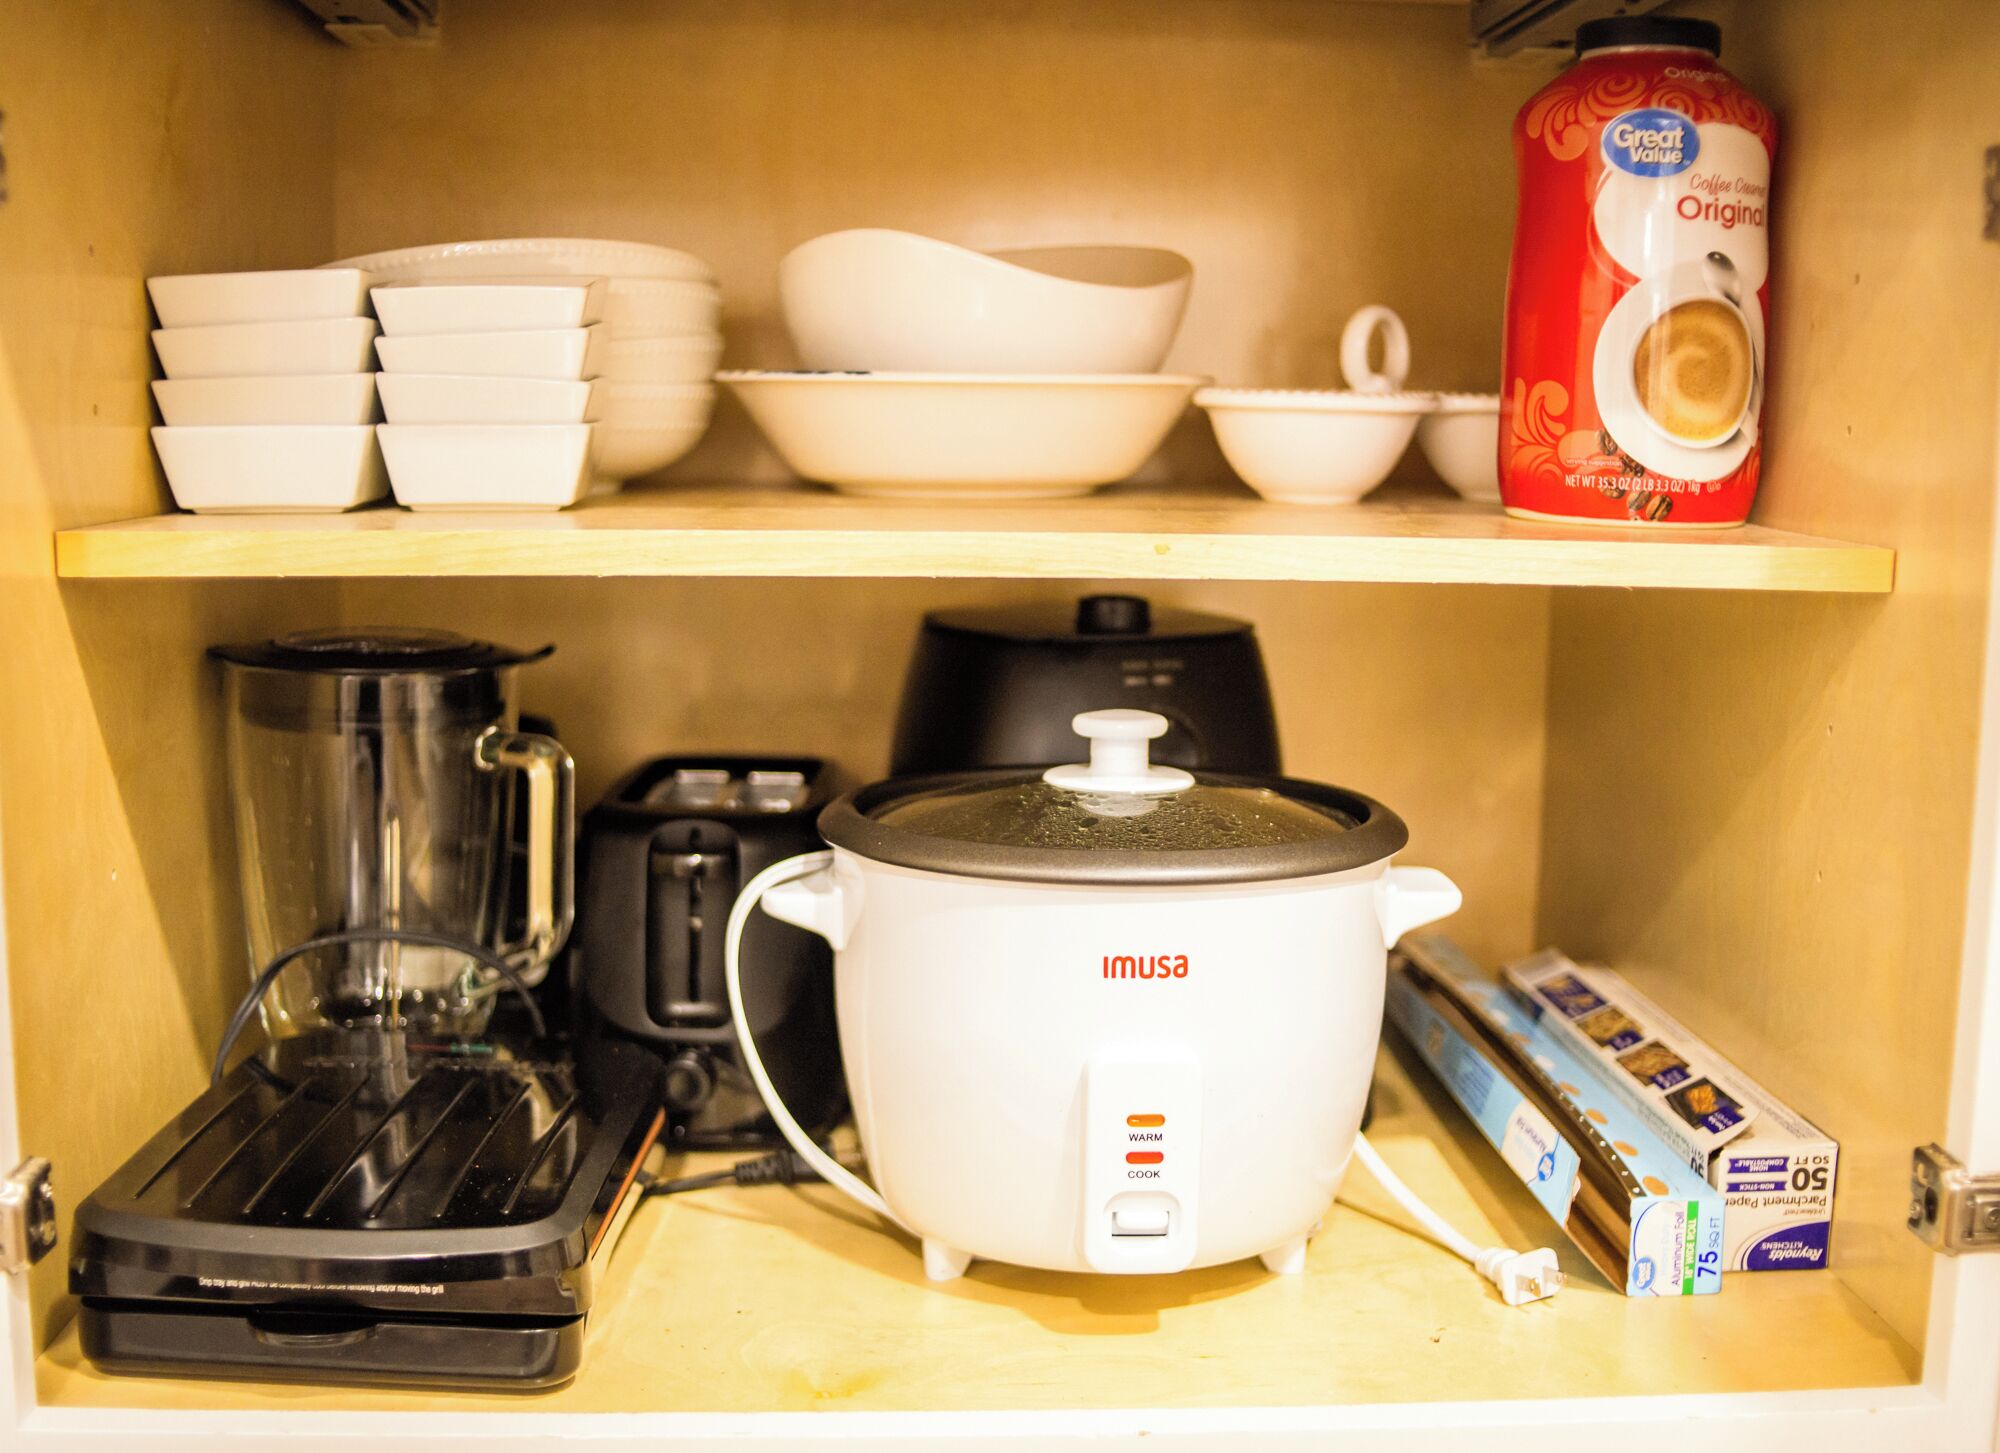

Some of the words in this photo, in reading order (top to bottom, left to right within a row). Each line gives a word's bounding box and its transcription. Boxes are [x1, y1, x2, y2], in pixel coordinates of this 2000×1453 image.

[1613, 123, 1684, 149] Great
[1630, 147, 1683, 164] Value
[1690, 173, 1732, 196] Coffee
[1565, 474, 1581, 488] NET
[1582, 475, 1596, 489] WT
[1597, 476, 1617, 490] 35.3
[1618, 478, 1631, 491] OZ
[1631, 478, 1641, 492] (2
[1642, 479, 1654, 492] LB
[1655, 479, 1669, 492] 3.3
[1670, 480, 1686, 493] OZ)
[1687, 479, 1701, 495] 1kg
[1128, 1132, 1164, 1143] WARM
[1793, 1156, 1809, 1166] FT
[1811, 1155, 1830, 1165] SQ
[1127, 1169, 1161, 1179] COOK
[1791, 1167, 1829, 1192] 50
[1739, 1182, 1776, 1191] NON-STICK
[1725, 1194, 1759, 1209] Paper
[1763, 1195, 1827, 1208] Parchment
[1674, 1211, 1685, 1229] Foil
[1709, 1216, 1721, 1229] FT
[1687, 1218, 1697, 1241] ROLL
[1708, 1231, 1720, 1249] SQ
[1761, 1240, 1804, 1250] KITCHENS
[1671, 1233, 1683, 1286] Aluminum
[1685, 1243, 1695, 1265] WIDE
[1769, 1245, 1823, 1262] Reynolds
[1697, 1251, 1718, 1278] 75
